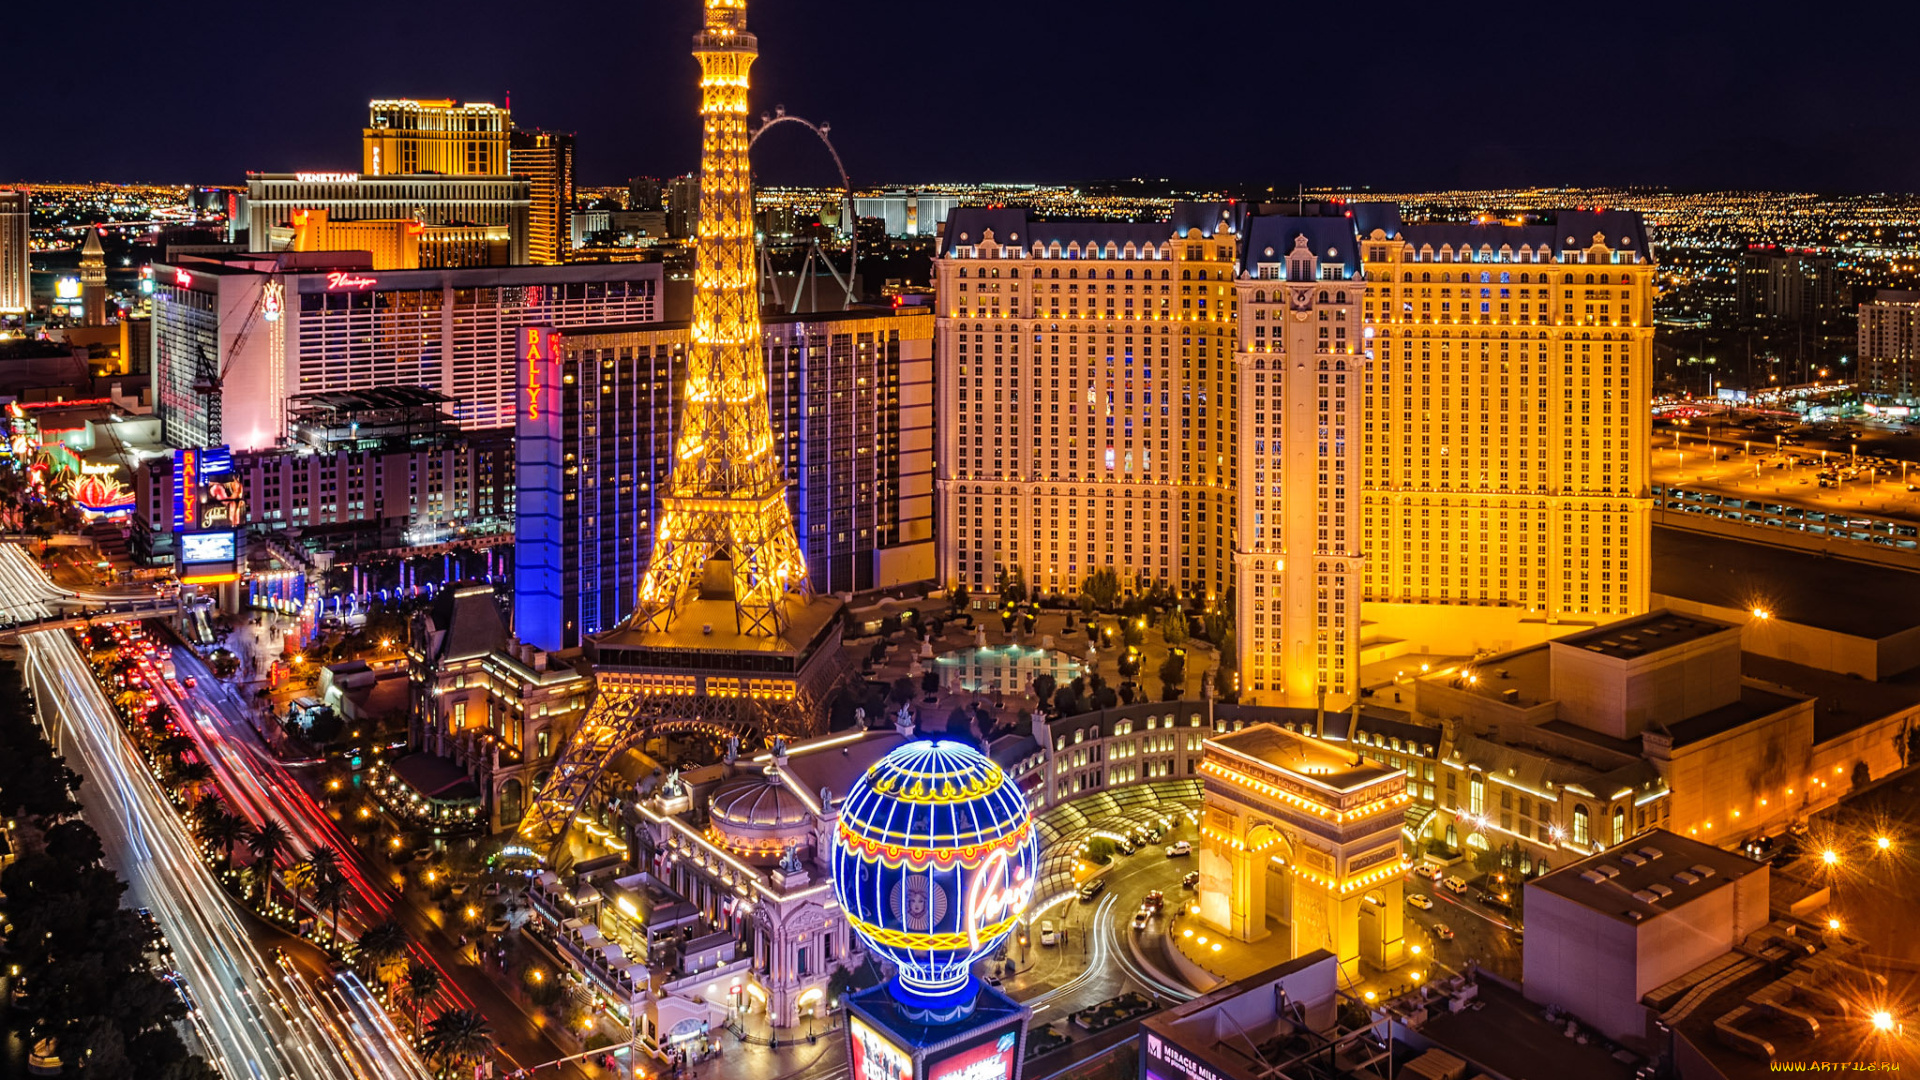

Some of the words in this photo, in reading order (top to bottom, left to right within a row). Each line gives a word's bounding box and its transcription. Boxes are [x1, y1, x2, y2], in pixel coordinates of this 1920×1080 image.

[296, 172, 358, 182] VENETIAN
[326, 271, 377, 290] Flamingo
[526, 328, 541, 420] BALLYS
[183, 451, 195, 522] BALLYS
[967, 847, 1033, 951] Paris
[1164, 1045, 1197, 1072] MIRACLE
[1198, 1065, 1217, 1080] MILE
